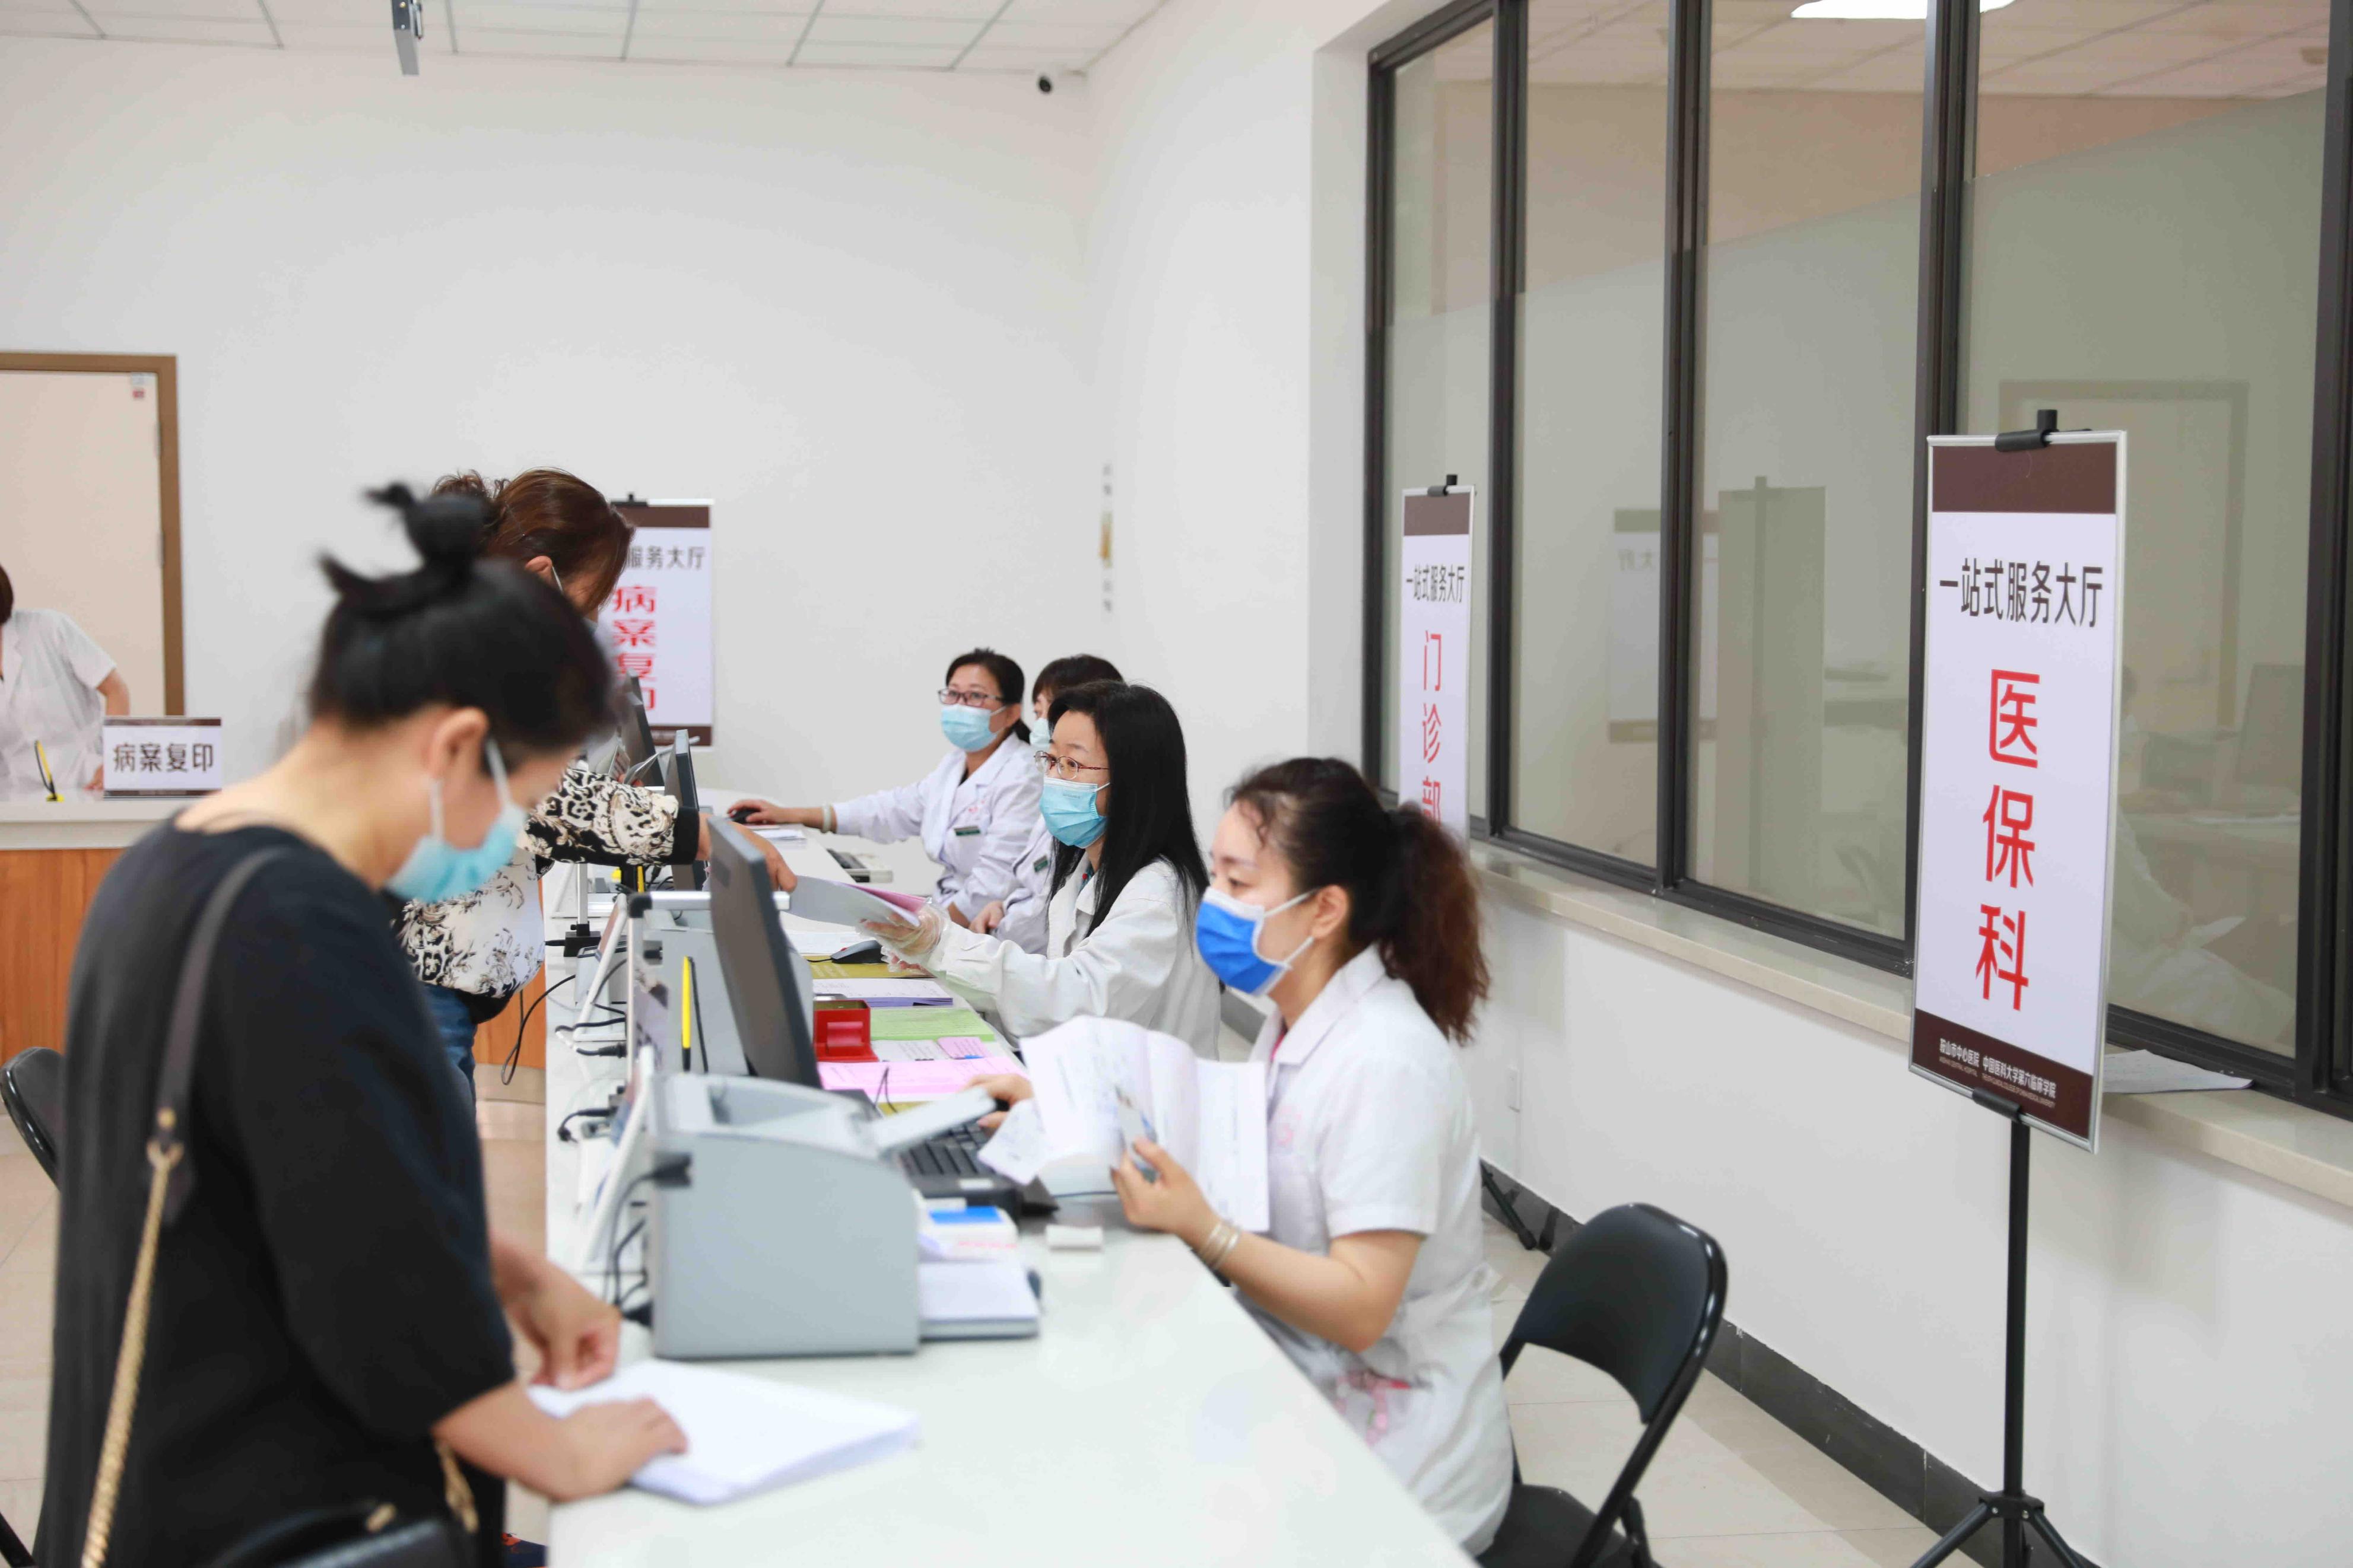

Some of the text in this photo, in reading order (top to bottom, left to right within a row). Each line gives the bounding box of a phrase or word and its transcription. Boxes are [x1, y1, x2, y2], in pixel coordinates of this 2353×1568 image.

[1406, 563, 1465, 603] 一站式服务大厅
[1939, 558, 2103, 627] 一站式服务大厅
[113, 742, 214, 773] 病案复印
[1976, 669, 2040, 1012] 医保科
[1939, 1038, 1980, 1068] 鞍山市中心医院
